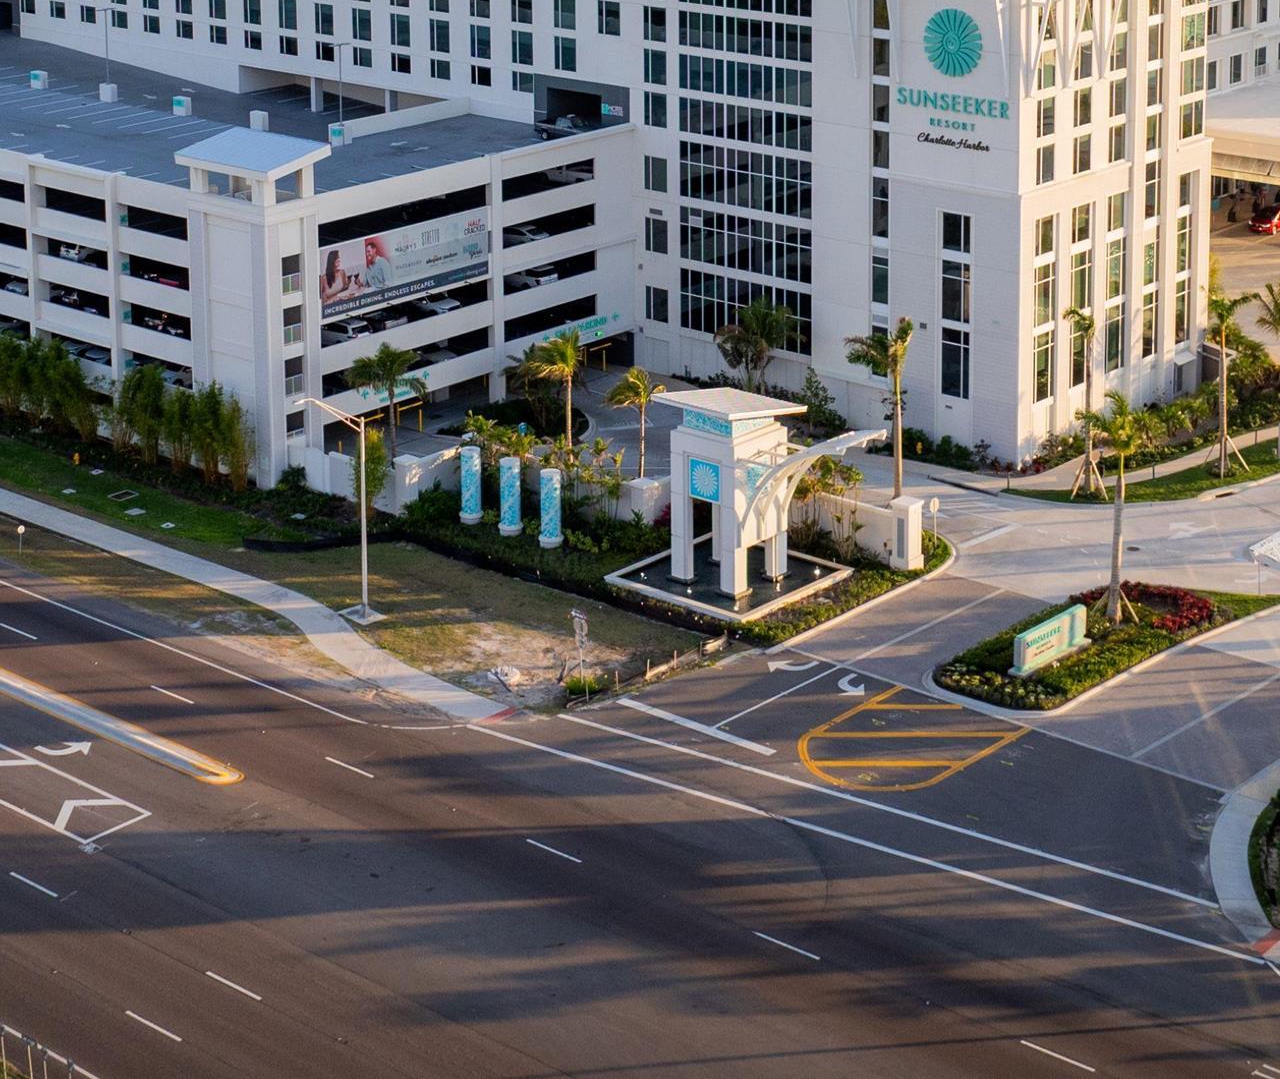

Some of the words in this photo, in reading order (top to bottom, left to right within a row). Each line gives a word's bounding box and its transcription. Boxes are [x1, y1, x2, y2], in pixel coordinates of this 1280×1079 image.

[896, 86, 1010, 120] SUNSEEKER
[929, 117, 976, 132] RESORT
[917, 132, 955, 148] Charlotte
[955, 137, 990, 152] Harbor
[324, 300, 360, 315] INCREDIBLE
[360, 294, 383, 307] DINING.
[384, 286, 410, 299] ENDLESS
[410, 279, 436, 293] ESCAPES.
